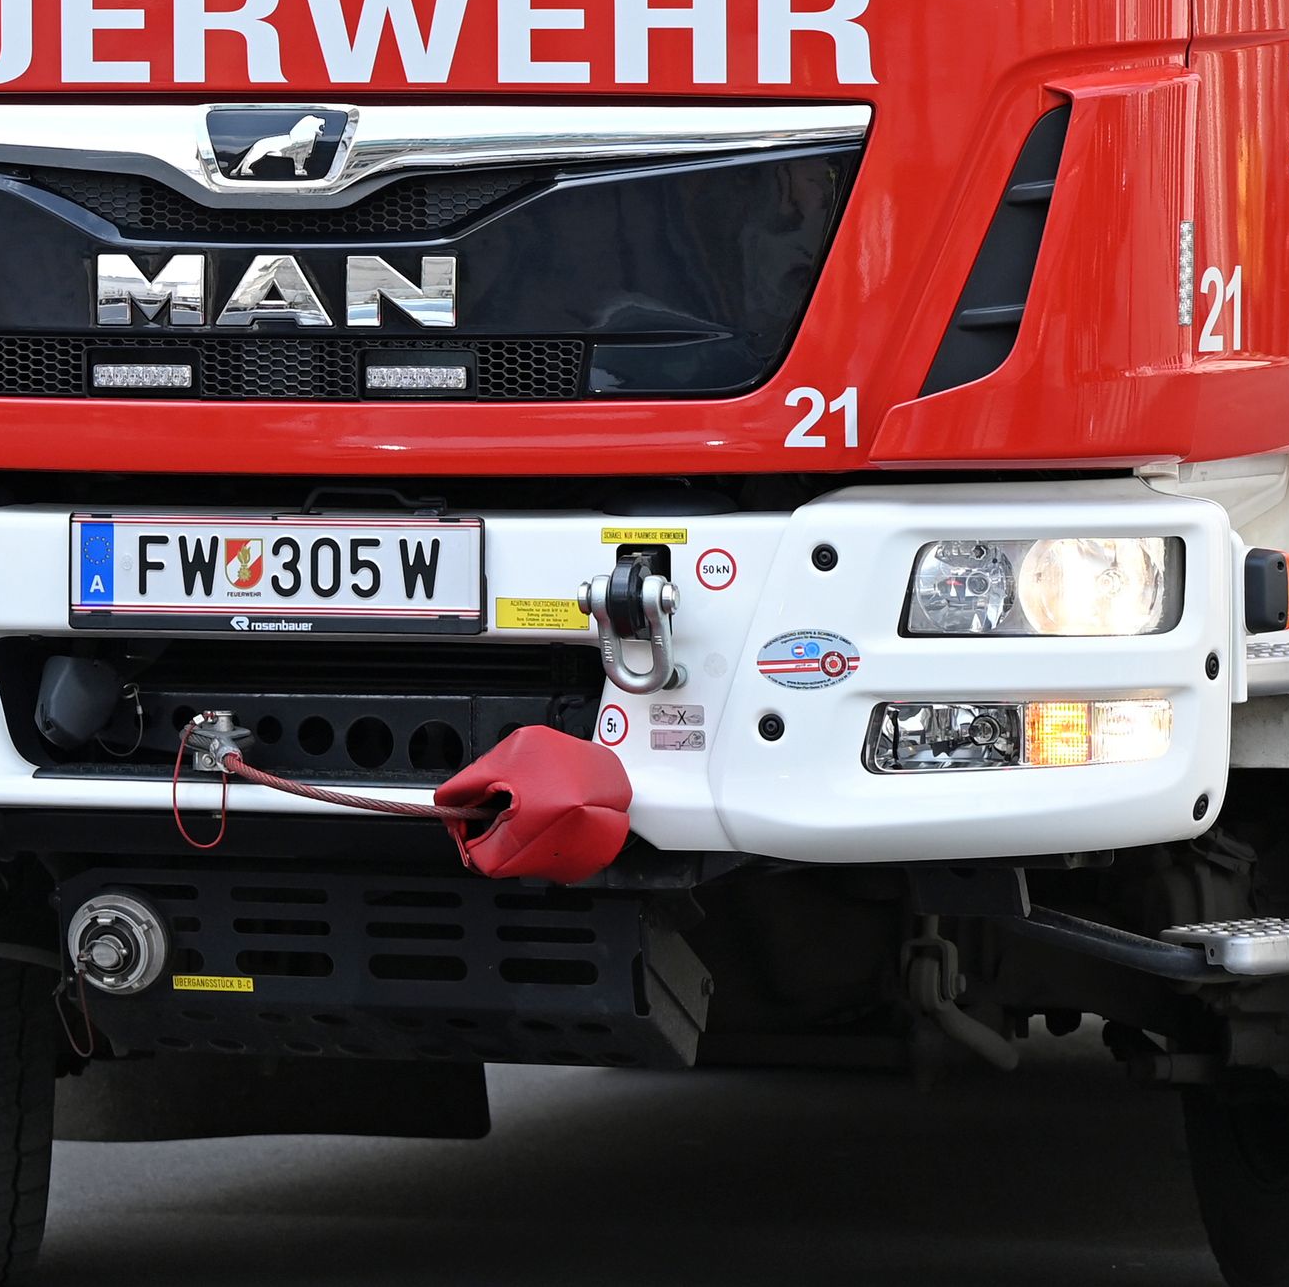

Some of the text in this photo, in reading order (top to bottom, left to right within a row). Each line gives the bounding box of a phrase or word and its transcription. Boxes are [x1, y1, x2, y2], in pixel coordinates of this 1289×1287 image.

[96, 254, 458, 328] MAN
[1198, 265, 1242, 352] 21
[784, 387, 859, 448] 21
[138, 535, 440, 600] FW 305 W
[703, 565, 729, 574] 50 kN
[89, 574, 105, 593] A
[251, 619, 313, 631] rosenbauer
[606, 718, 617, 733] 5t
[174, 977, 235, 989] ÜBERGANGSSTÜCK
